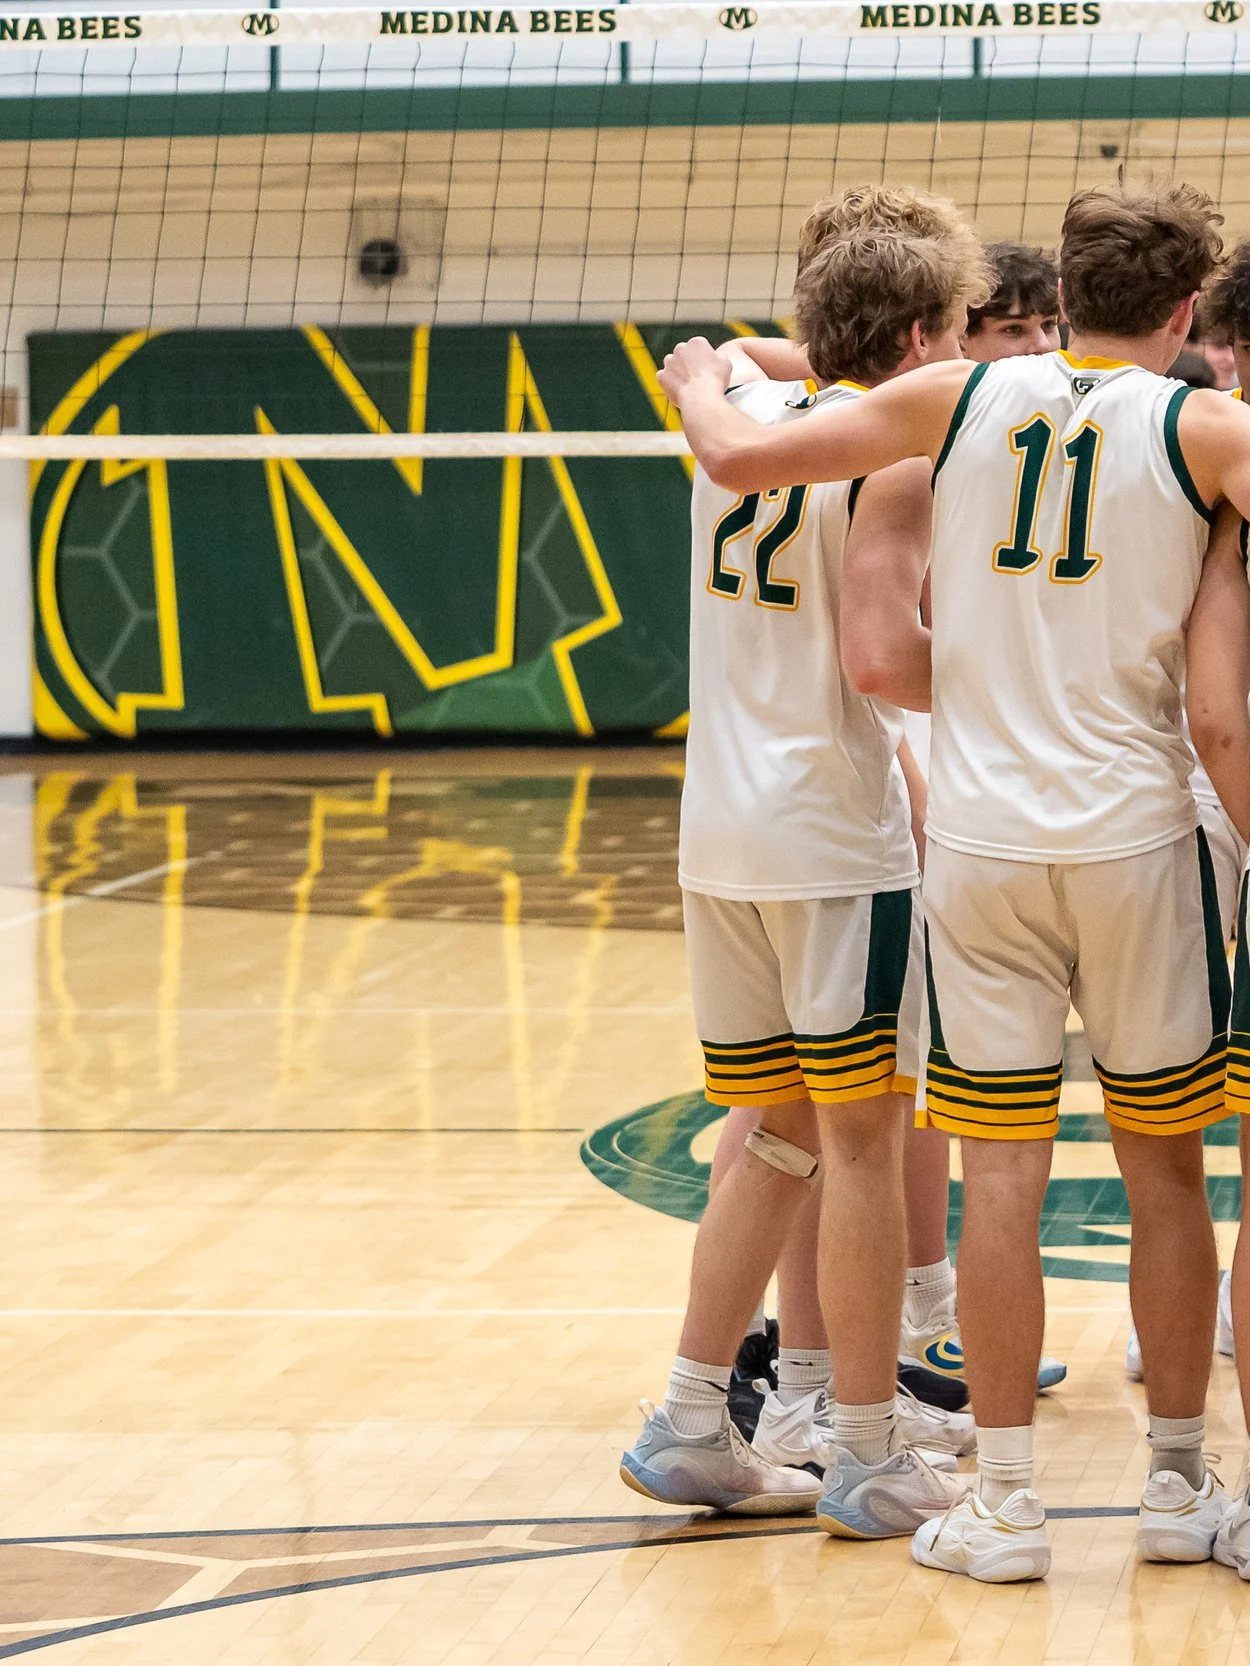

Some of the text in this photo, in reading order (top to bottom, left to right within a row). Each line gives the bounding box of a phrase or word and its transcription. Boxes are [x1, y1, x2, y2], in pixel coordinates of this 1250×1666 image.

[57, 16, 142, 40] BEES
[380, 9, 617, 34] MEDINA BEES
[861, 3, 1101, 28] MEDINA BEES
[991, 411, 1104, 585] 11
